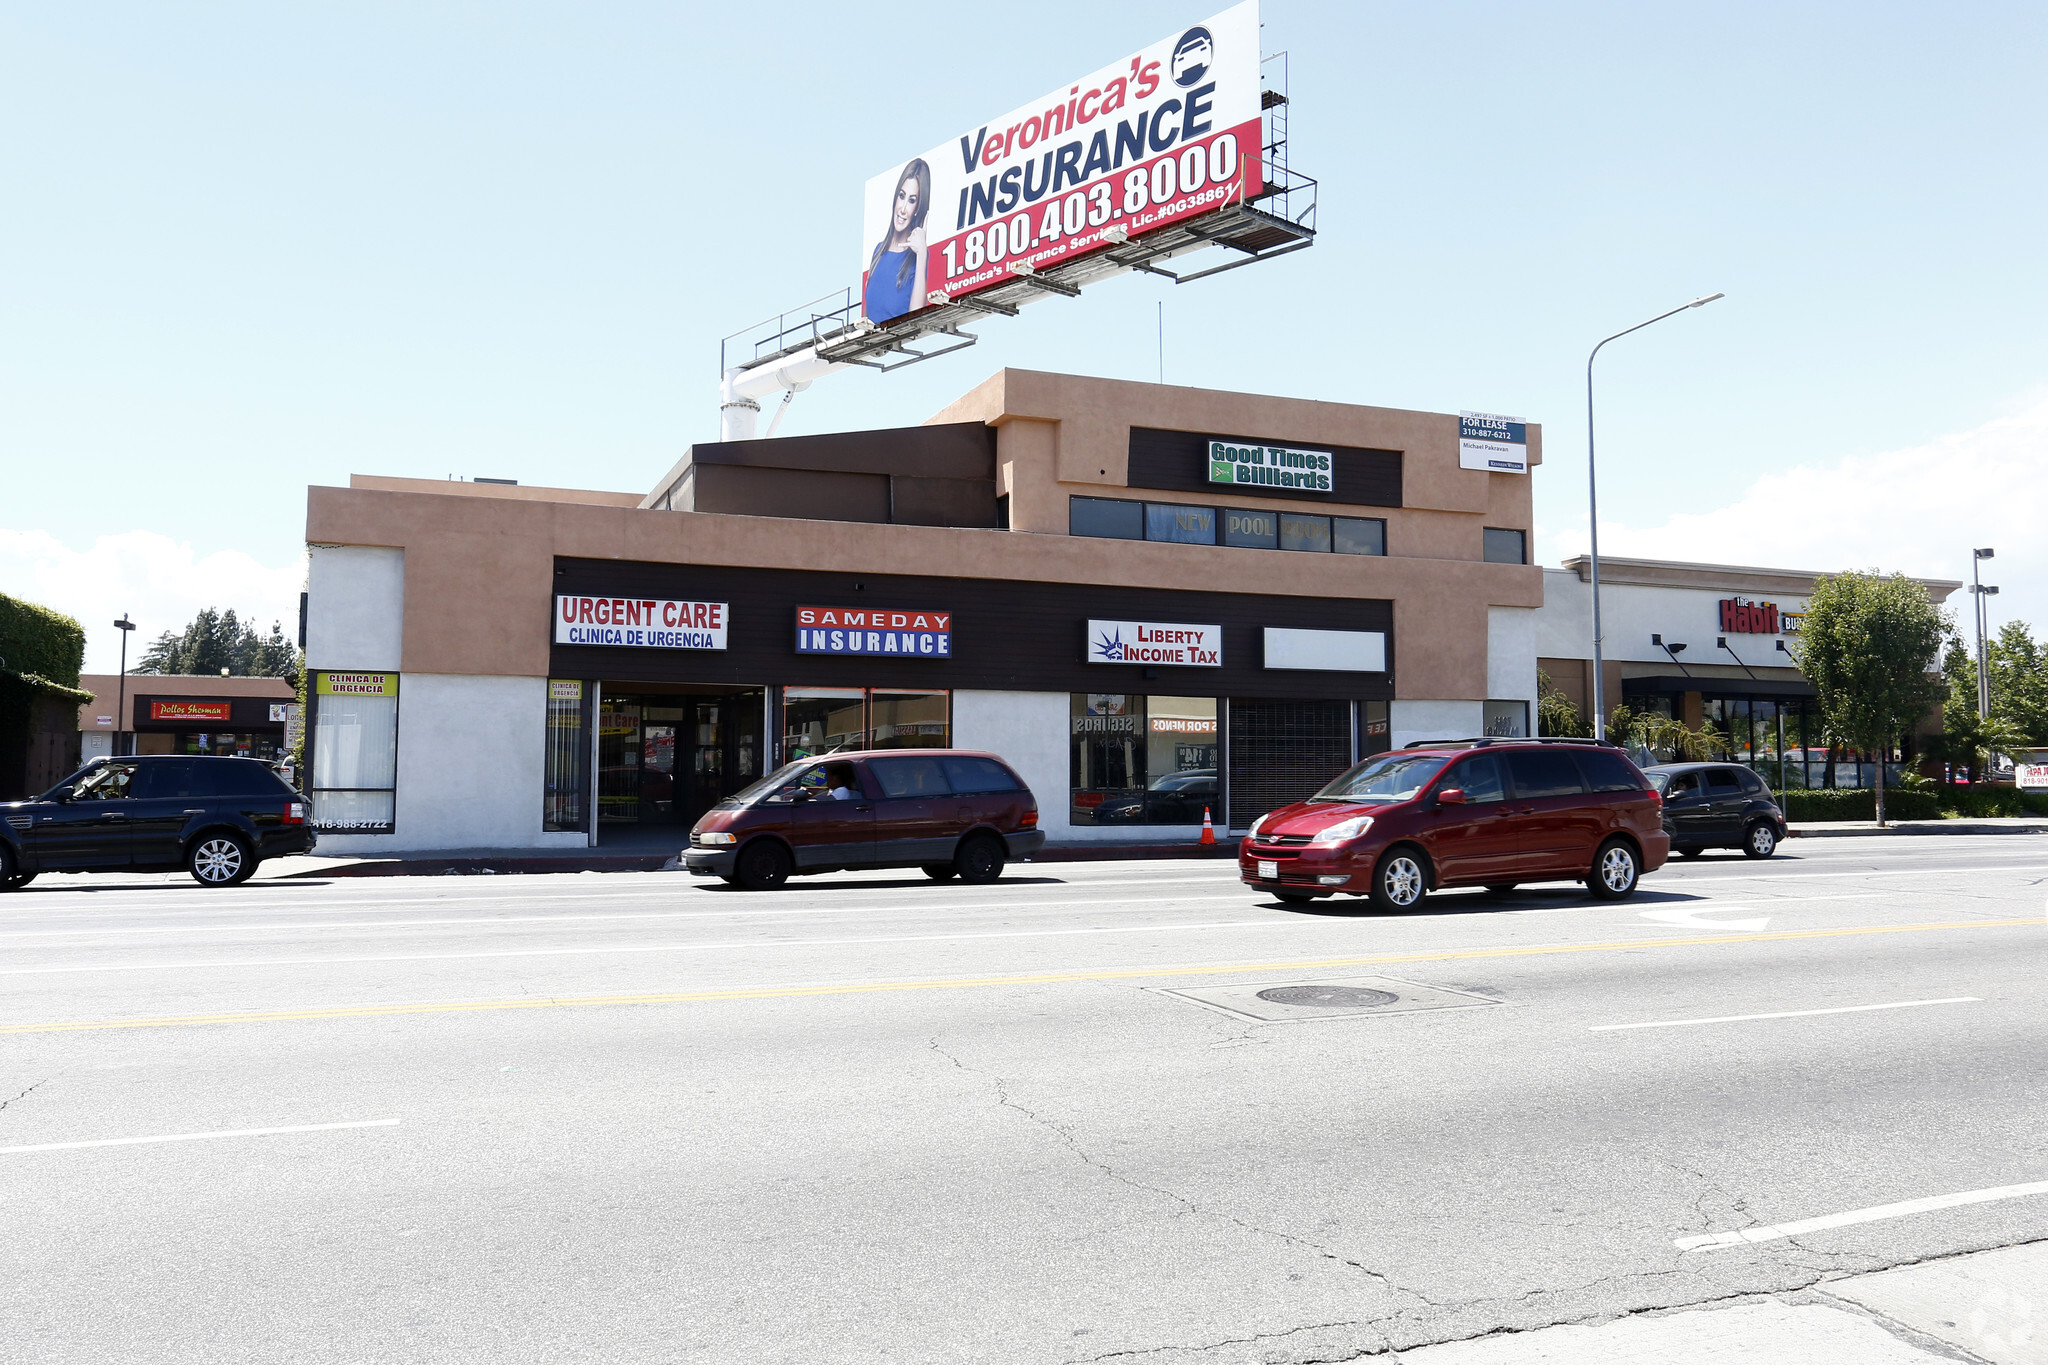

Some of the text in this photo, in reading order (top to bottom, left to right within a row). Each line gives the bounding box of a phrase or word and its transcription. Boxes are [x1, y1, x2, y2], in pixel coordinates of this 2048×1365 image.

[960, 55, 1161, 174] Veronica's
[956, 81, 1216, 231] INSURANCE
[941, 133, 1238, 279] 1.800.403.8000
[944, 266, 1003, 293] Veronica's
[1462, 417, 1507, 430] FOR LEASE
[1462, 428, 1511, 440] 310-887-6212
[1211, 442, 1329, 470] Good Times
[1236, 464, 1330, 489] Billiards
[1175, 512, 1212, 531] NEW
[1229, 516, 1274, 537] POOL
[1736, 597, 1749, 607] the
[562, 597, 722, 629] URGENT CARE
[800, 610, 949, 629] SAMEDAY
[1720, 599, 1779, 634] Habit
[569, 627, 714, 648] CLINICA DE URGENCIA
[800, 629, 948, 654] INSURANCE
[1138, 625, 1204, 644] LIBERTY
[1124, 644, 1218, 664] INCOME TAX
[328, 674, 385, 684] CLINICA DE
[332, 684, 384, 693] URGENCIA
[160, 703, 185, 715] Pollos
[615, 713, 639, 728] Care
